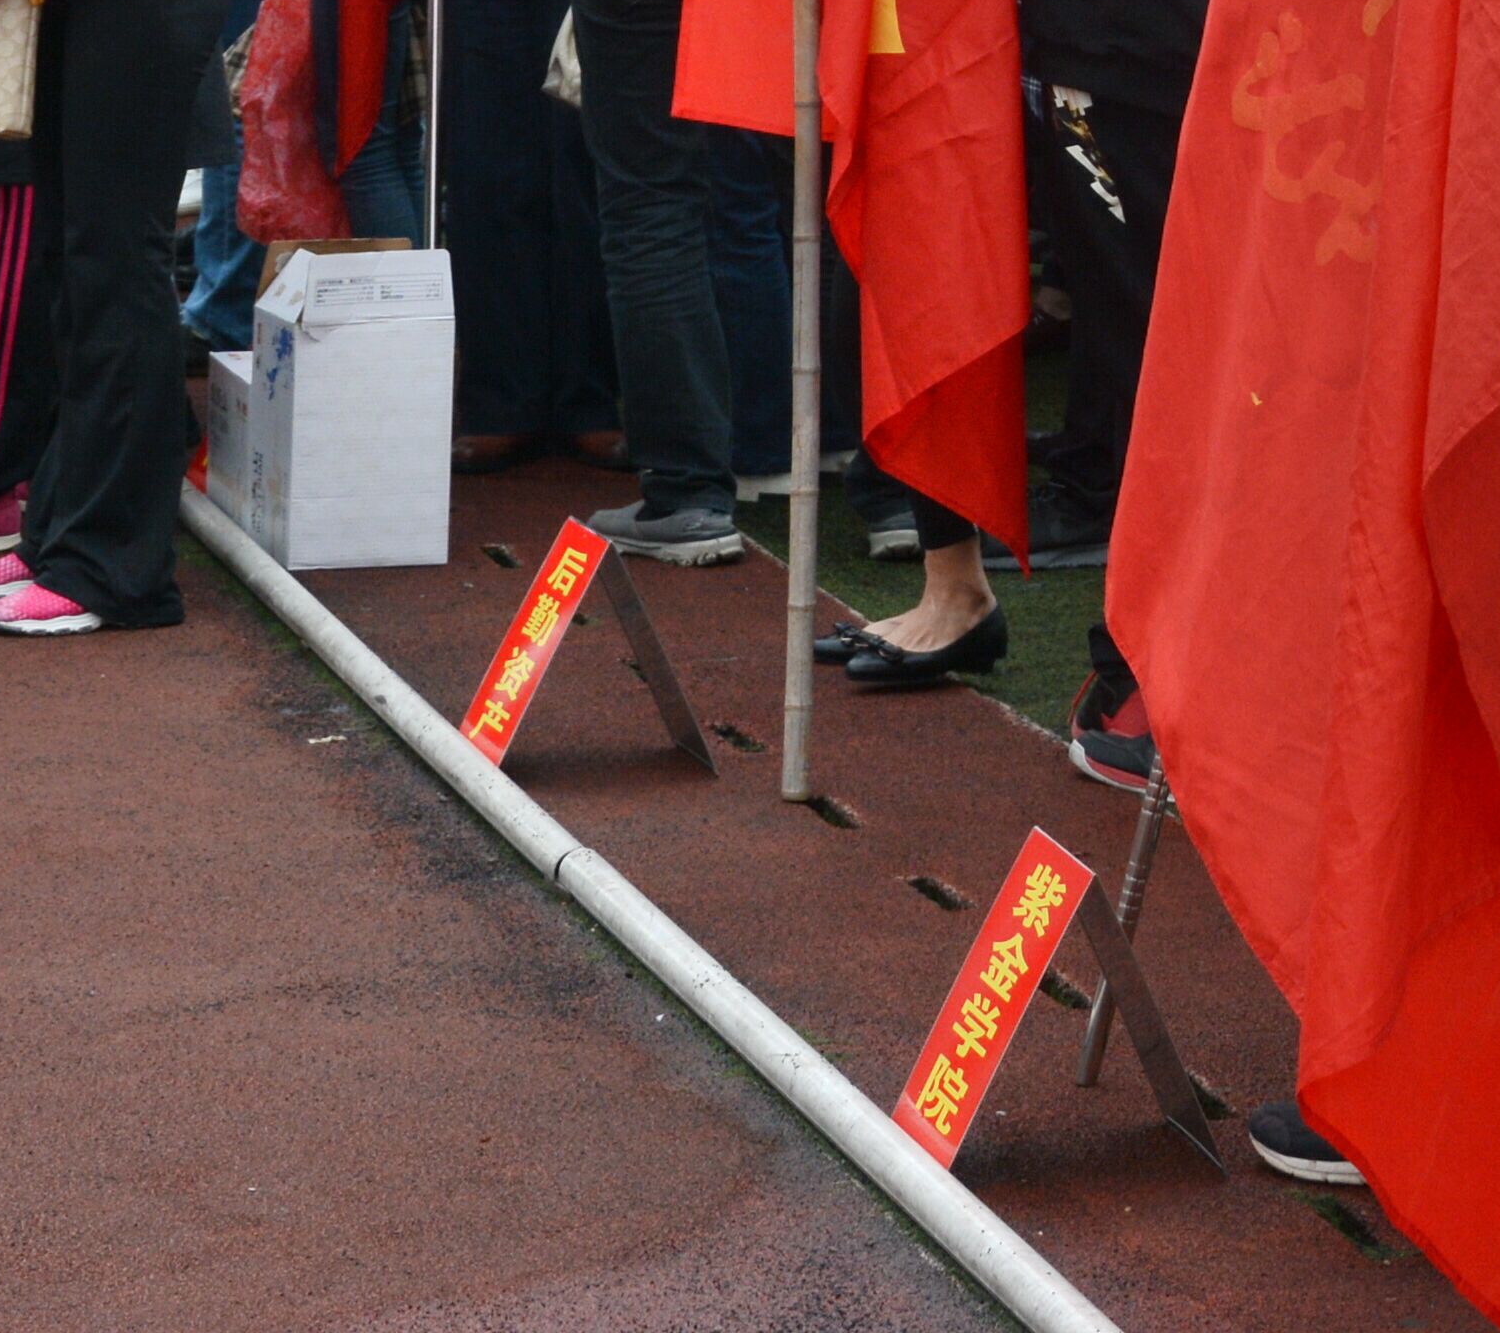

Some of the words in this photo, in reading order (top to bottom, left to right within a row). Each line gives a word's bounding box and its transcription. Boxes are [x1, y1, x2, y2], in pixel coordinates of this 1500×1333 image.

[469, 547, 588, 739] 后勤资产
[916, 863, 1067, 1135] 紫金学院
